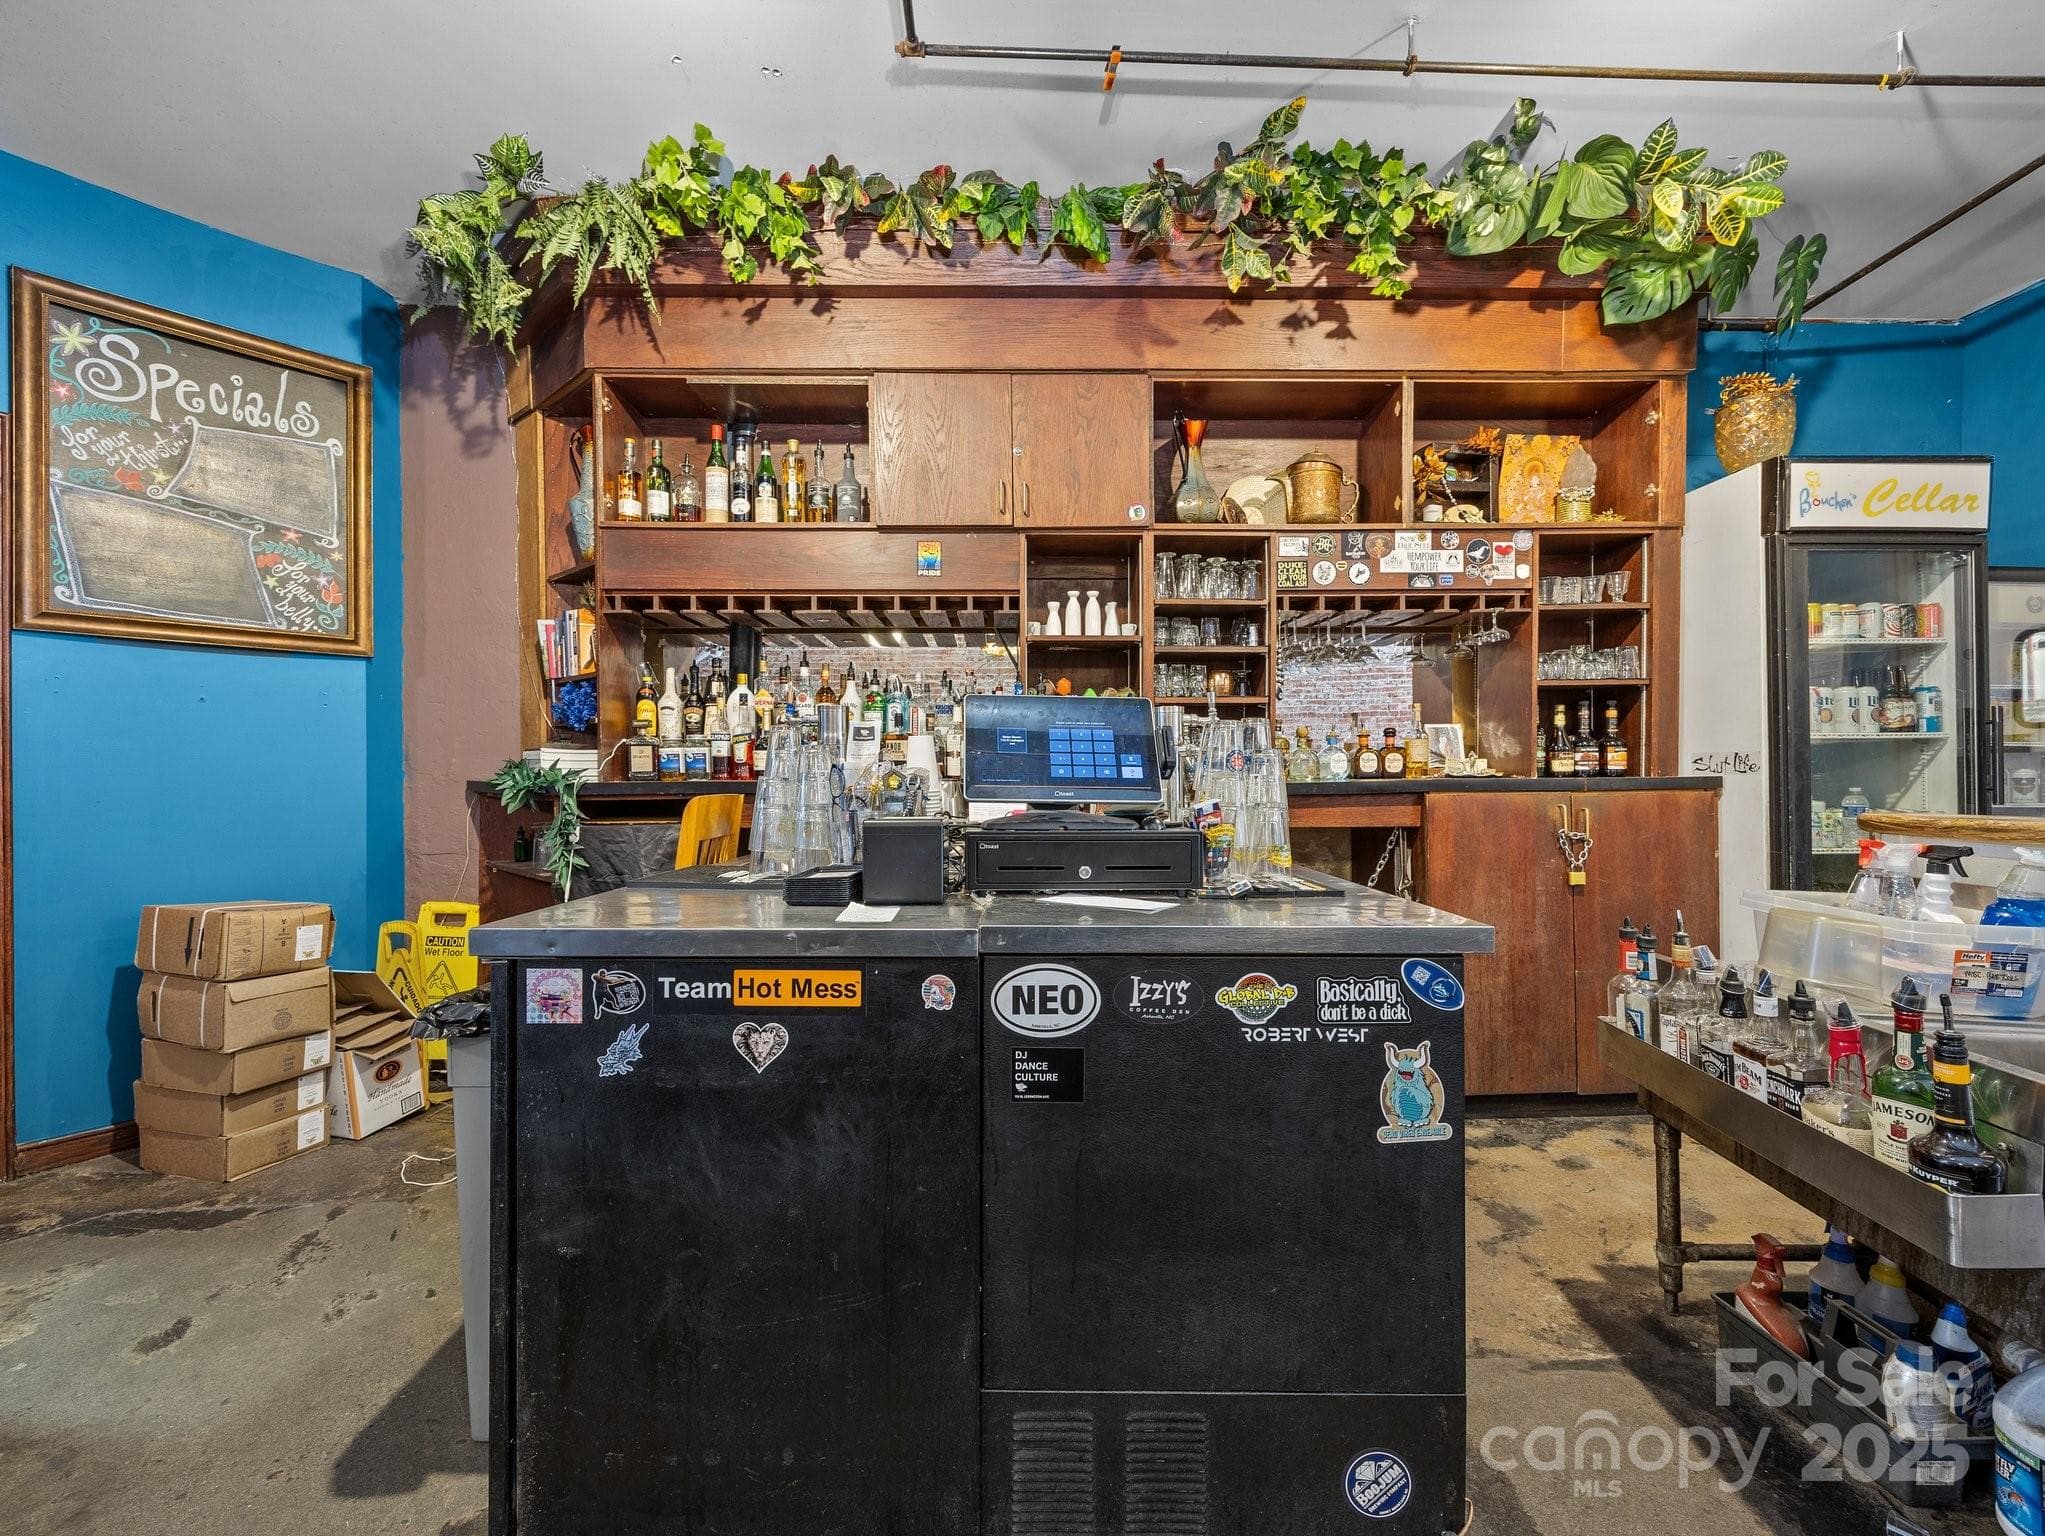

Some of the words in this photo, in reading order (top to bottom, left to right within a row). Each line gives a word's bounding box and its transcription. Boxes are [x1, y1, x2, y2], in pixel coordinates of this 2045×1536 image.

[75, 334, 320, 438] Specials
[1862, 478, 1980, 518] Cellar
[1407, 552, 1441, 561] HEMPOWER
[1410, 562, 1425, 571] YOUR
[1427, 561, 1439, 571] LIFE
[1692, 755, 1730, 773] Slut
[1734, 752, 1760, 773] Life
[426, 936, 465, 947] CAUTION
[425, 948, 440, 956] Wet
[442, 948, 463, 956] Floor
[1961, 952, 1985, 961] Hefty
[658, 977, 732, 999] Team
[738, 977, 782, 999] Hot
[1012, 984, 1084, 1015] NEO
[1218, 989, 1269, 1004] GLOBAL
[1230, 999, 1285, 1008] COLLECTIVE
[1321, 1004, 1348, 1021] don't
[1352, 1004, 1366, 1020] be
[1369, 1007, 1376, 1020] a
[1380, 1003, 1407, 1020] dick
[1241, 1028, 1311, 1042] ROBERT
[1316, 1028, 1369, 1042] WEST
[1015, 1051, 1027, 1059] DJ
[1015, 1062, 1048, 1070] DANCE
[1015, 1073, 1058, 1081] CULTURE
[1742, 1062, 1762, 1085] BEAM
[1804, 1113, 1835, 1138] aker's
[1355, 1463, 1403, 1507] BOOJUM
